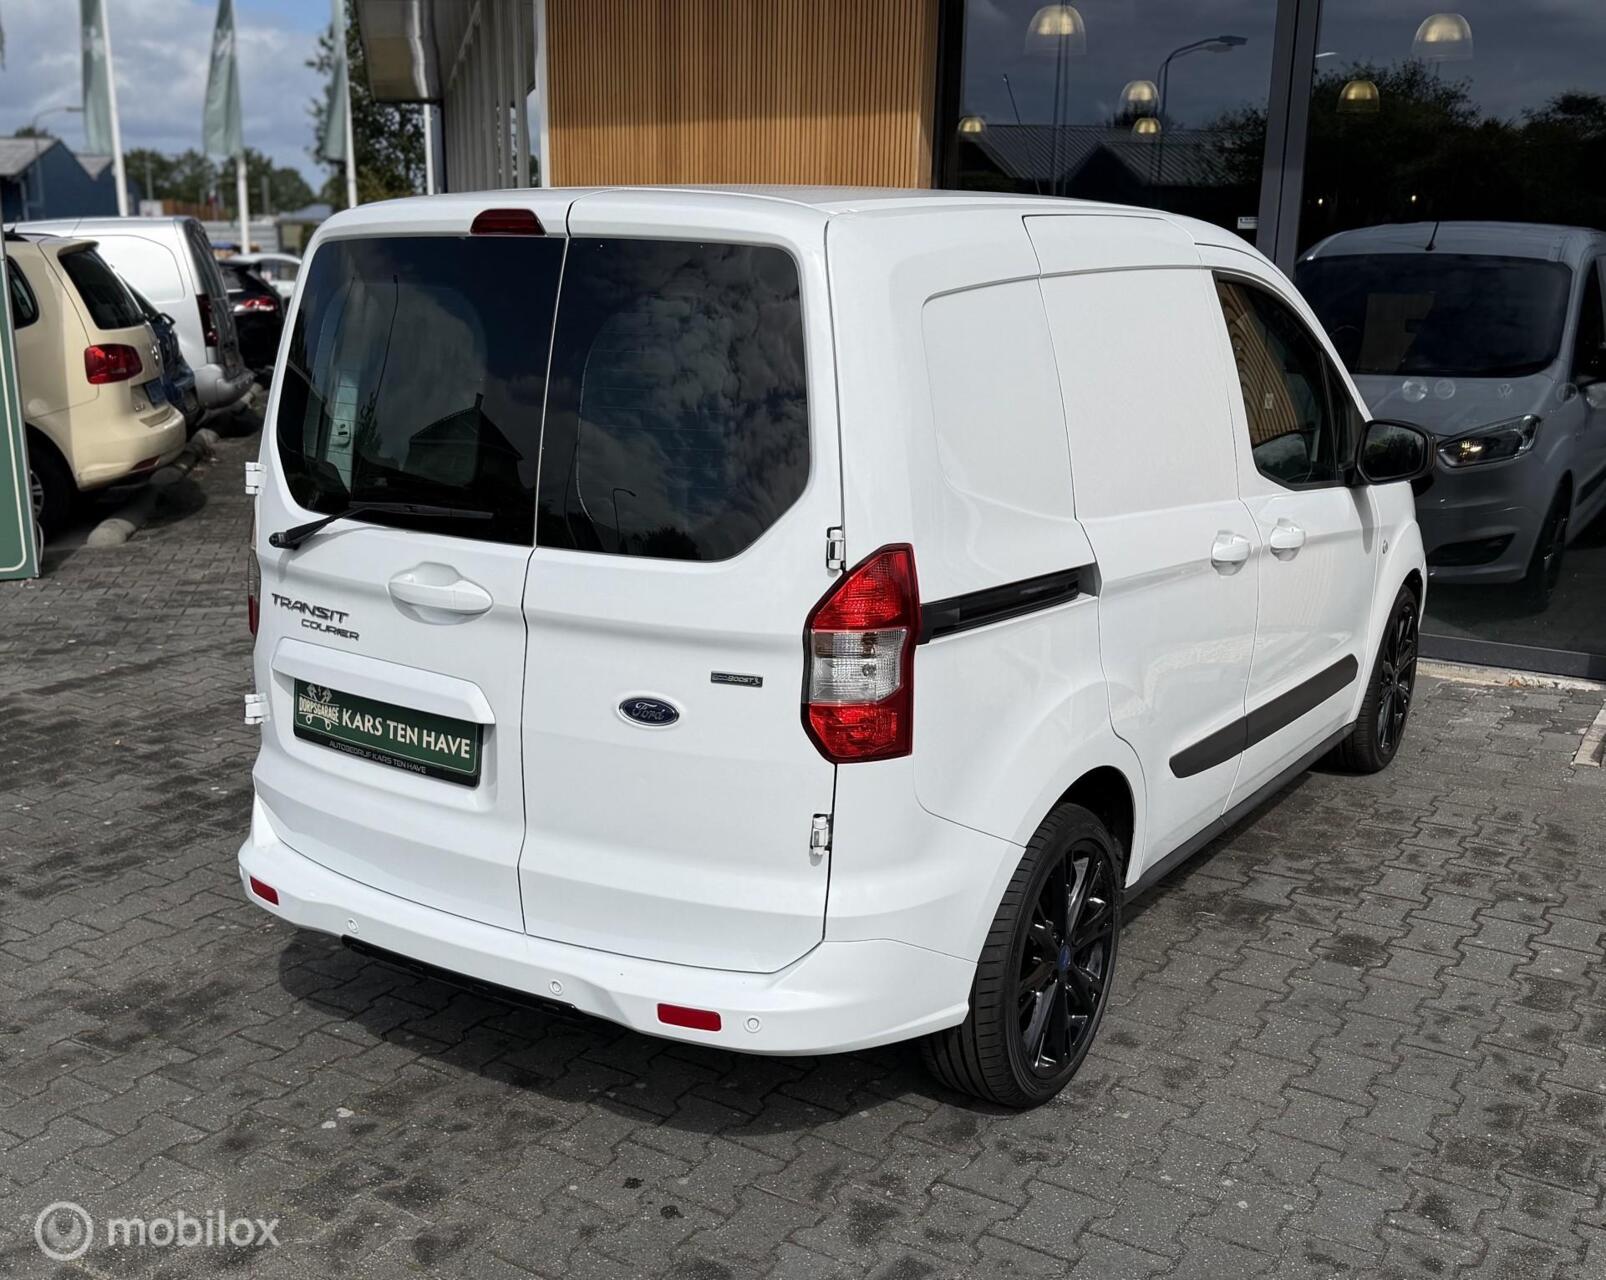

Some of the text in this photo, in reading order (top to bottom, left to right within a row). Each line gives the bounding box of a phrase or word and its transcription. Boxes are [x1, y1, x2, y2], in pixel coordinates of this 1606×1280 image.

[271, 592, 350, 625] TRANSIT
[301, 618, 360, 642] COURIER
[631, 701, 666, 721] Ford
[342, 707, 471, 759] KARS TEN HAVE
[372, 753, 392, 765] KARS
[393, 758, 407, 768] TEN
[406, 762, 427, 775] HAVE
